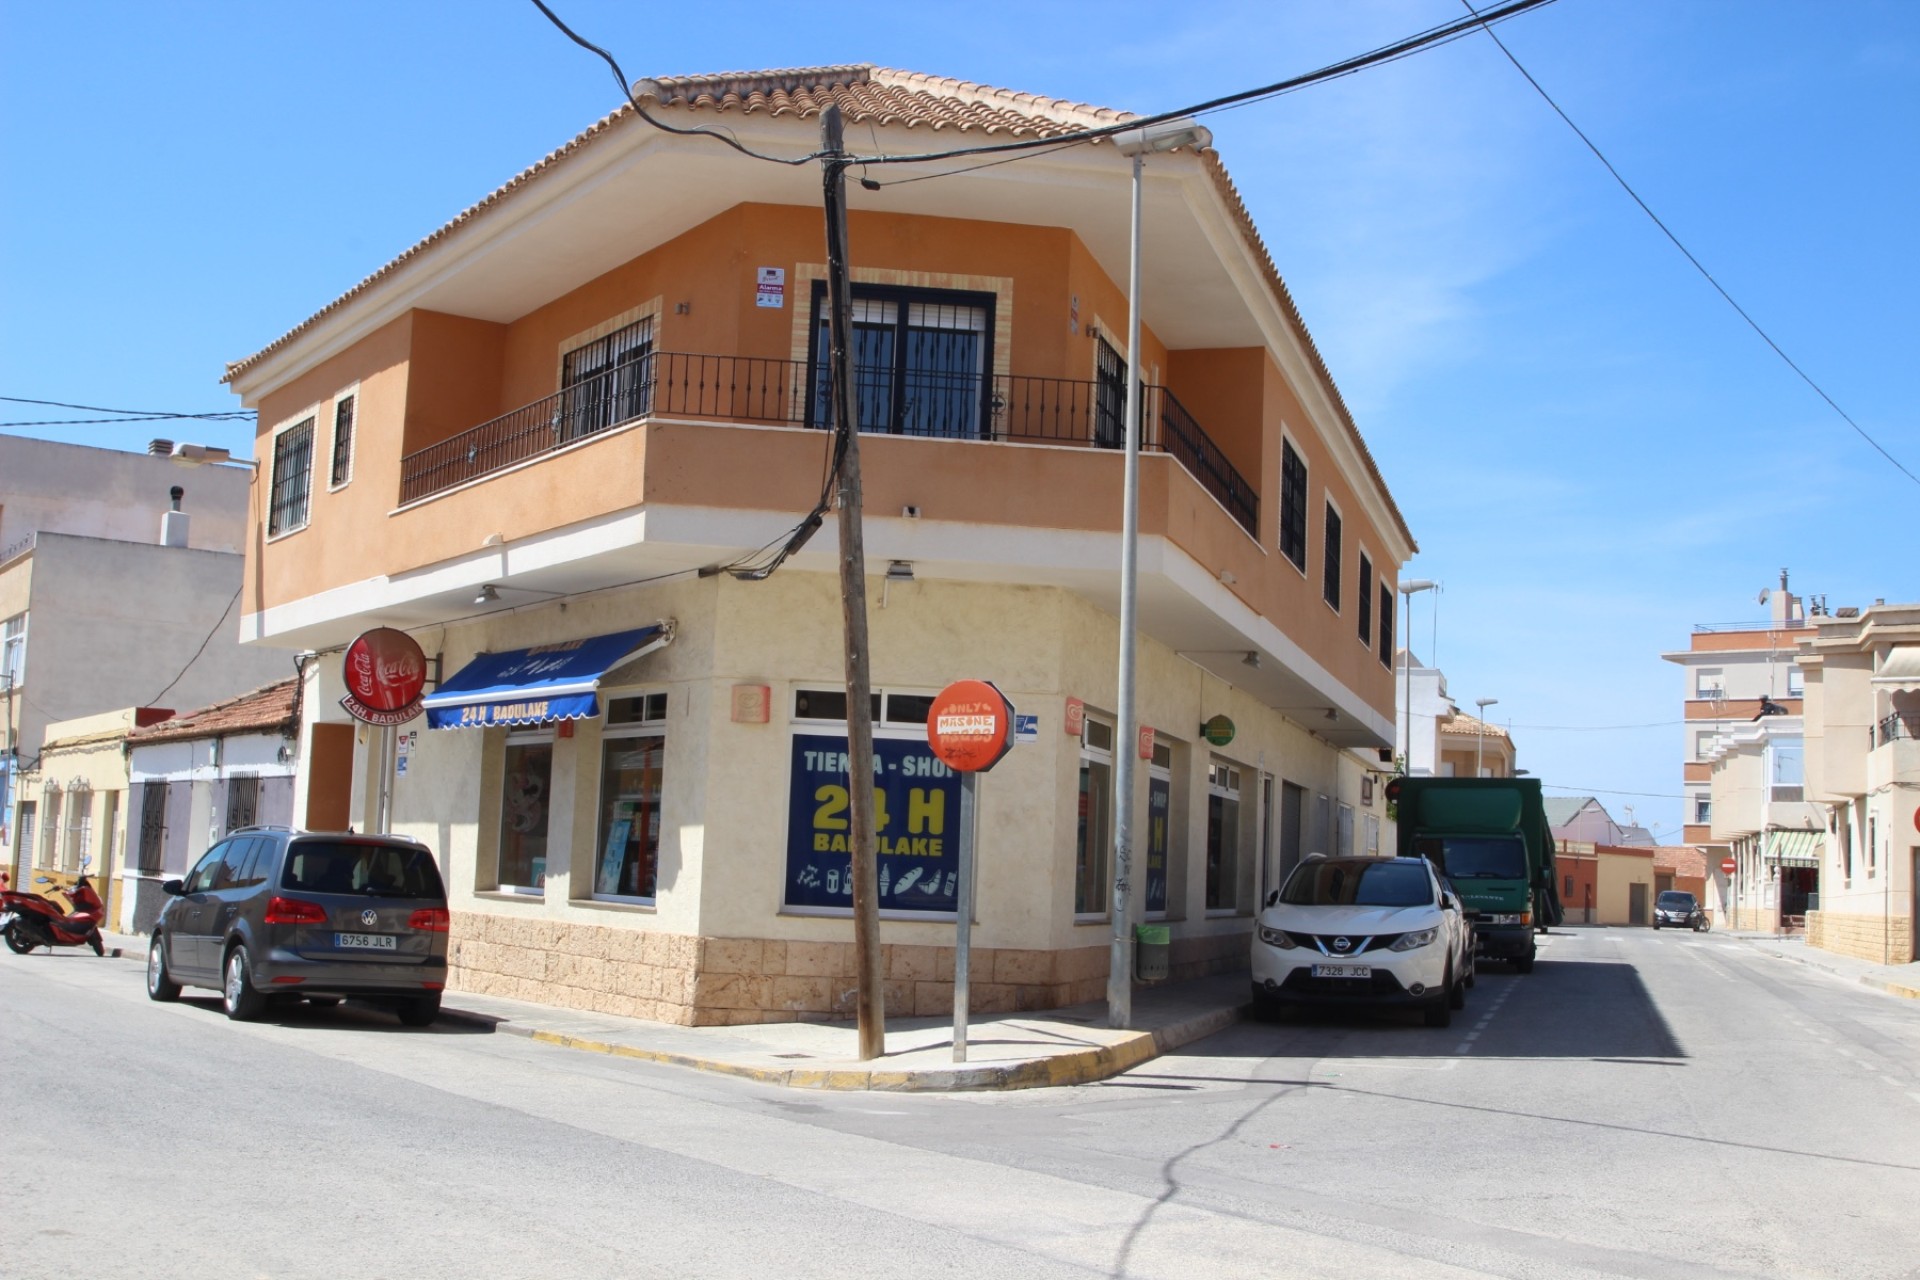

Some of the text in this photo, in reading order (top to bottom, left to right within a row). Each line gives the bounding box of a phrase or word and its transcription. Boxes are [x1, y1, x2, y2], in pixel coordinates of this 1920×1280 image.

[346, 698, 423, 724] 24H. BADULAK
[462, 701, 549, 723] 24 H BADULAKE
[949, 703, 981, 713] ONLY
[804, 751, 883, 775] TIENA
[908, 788, 945, 835] H
[813, 833, 943, 857] BALAKE
[342, 935, 392, 948] 6756 JLR
[1318, 966, 1344, 976] 7328
